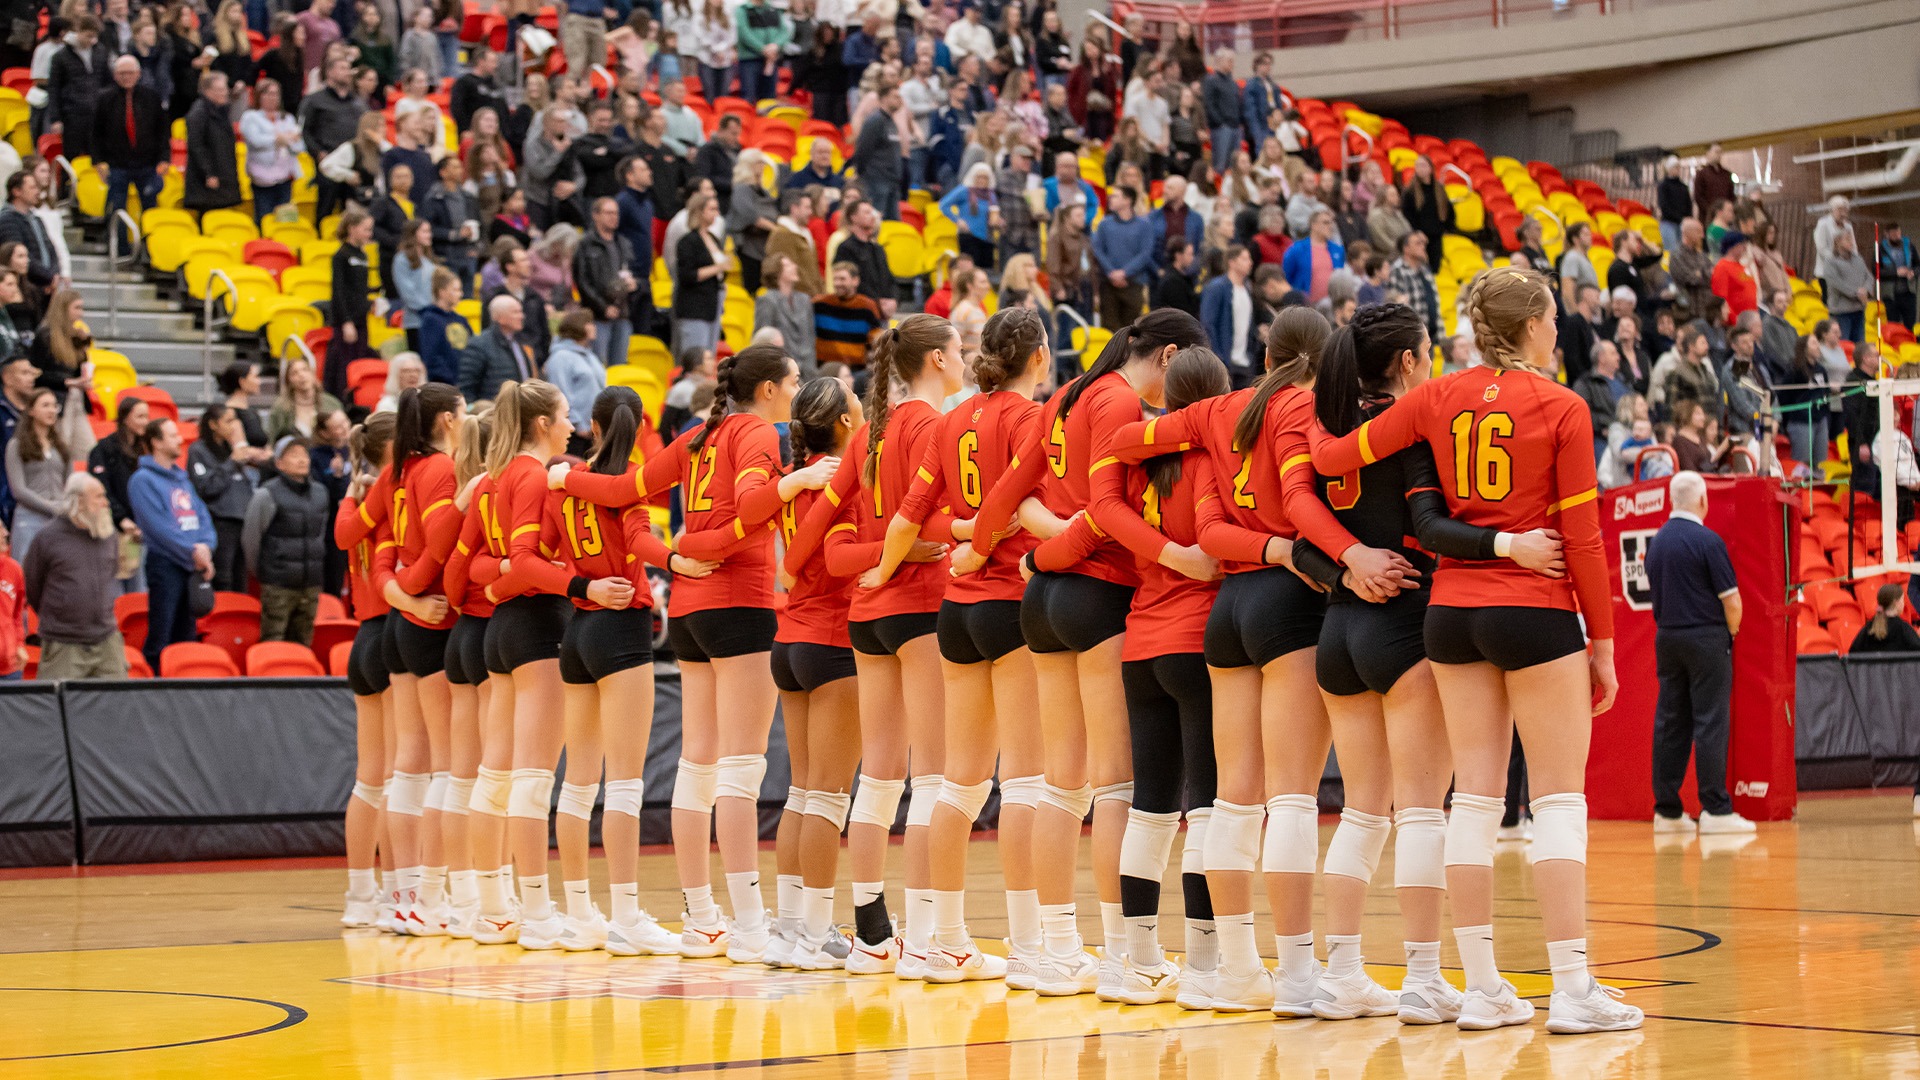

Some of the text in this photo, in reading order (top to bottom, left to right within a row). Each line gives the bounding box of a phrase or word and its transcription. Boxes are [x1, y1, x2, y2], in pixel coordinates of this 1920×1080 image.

[687, 444, 717, 513] 12
[958, 429, 982, 509] 6
[1049, 405, 1068, 479] 5
[1231, 437, 1257, 510] 2
[1450, 410, 1515, 502] 16
[478, 492, 508, 557] 14
[562, 495, 604, 560] 13
